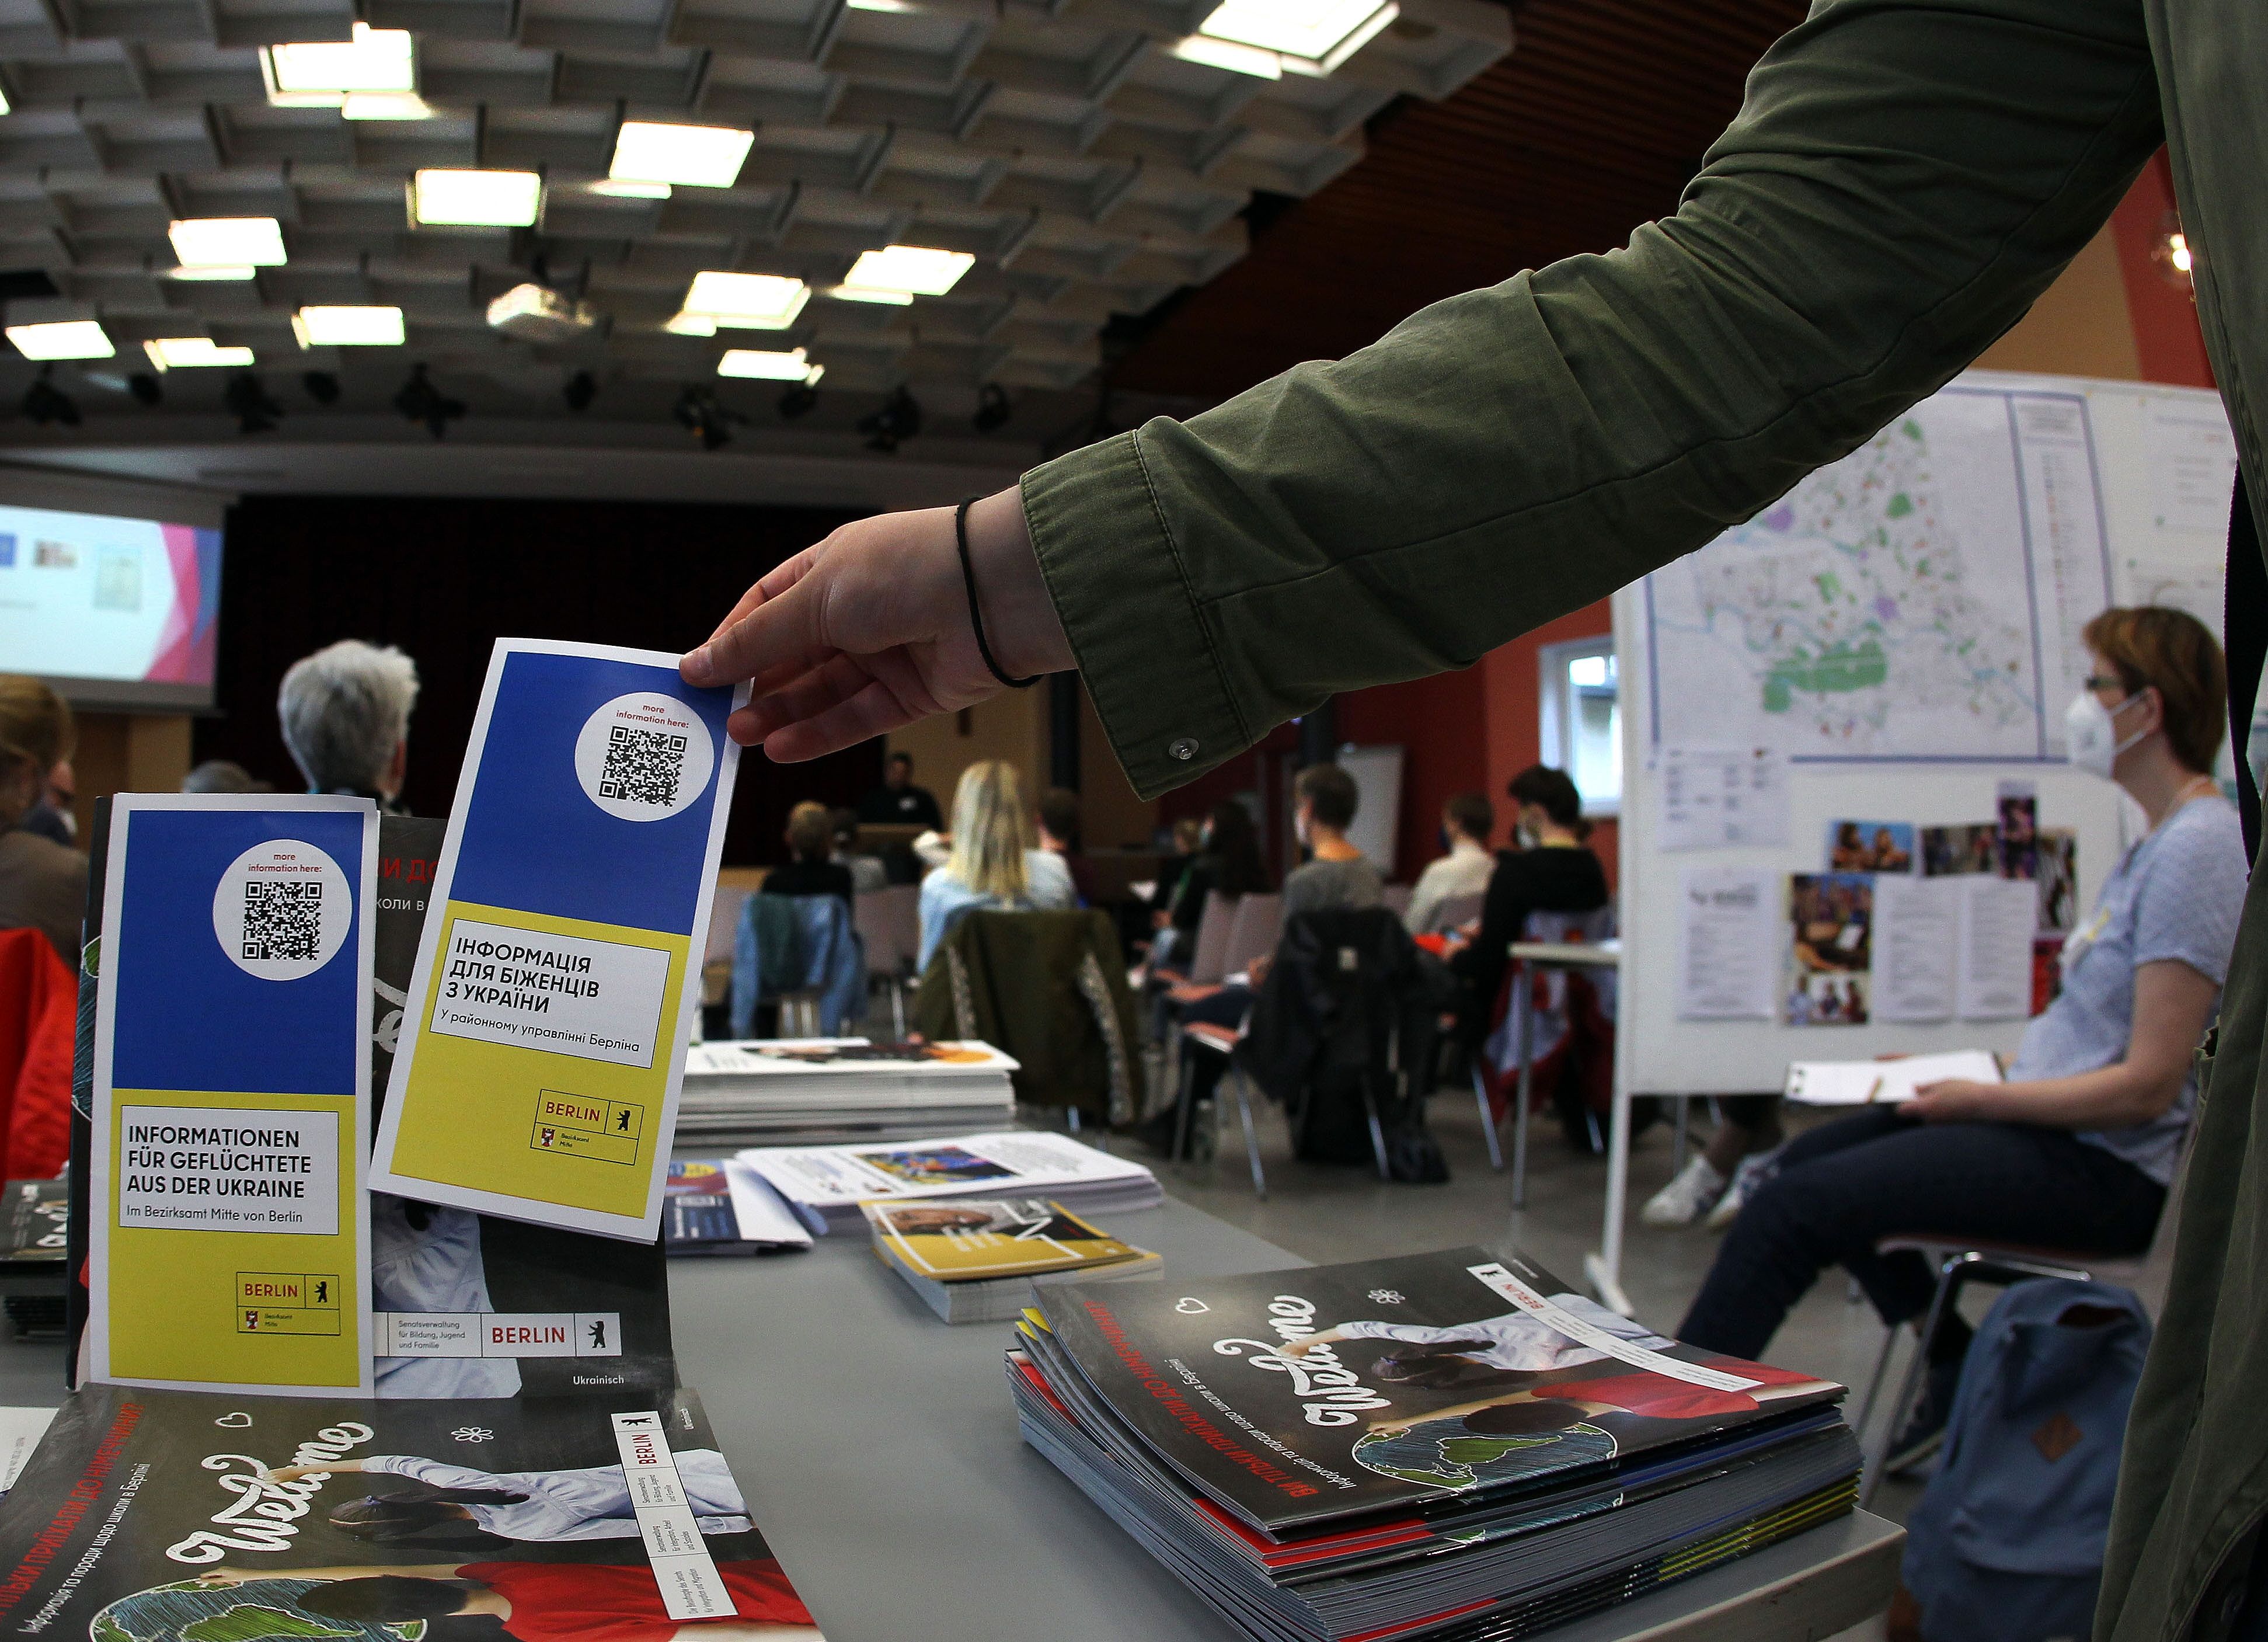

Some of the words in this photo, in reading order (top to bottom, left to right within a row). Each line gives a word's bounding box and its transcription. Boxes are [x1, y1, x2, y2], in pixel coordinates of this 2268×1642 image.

[616, 710, 665, 724] information
[667, 718, 689, 728] here:
[643, 705, 664, 714] more
[455, 937, 591, 973] ІНФОРМАЦІЯ
[450, 959, 494, 982] ДЛЯ
[500, 967, 600, 999] БІЖЕНЦІВ
[445, 982, 458, 999] З
[463, 983, 550, 1013] УКРАЇНИ
[451, 1013, 518, 1034] районному
[521, 1025, 586, 1043] управлінні
[590, 1034, 639, 1052] Берліна
[546, 1101, 600, 1122] BERLIN
[129, 1125, 299, 1147] INFORMATIONEN
[128, 1146, 165, 1168] FÜR
[171, 1149, 311, 1173] GEFLÜCHTETE
[127, 1175, 166, 1193] AUS
[172, 1177, 210, 1195] DER
[217, 1179, 304, 1198] UKRAINE
[127, 1205, 140, 1216] Im
[145, 1206, 207, 1219] Bezirksamt
[212, 1209, 240, 1220] Mitte
[243, 1213, 264, 1222] von
[269, 1210, 302, 1222] Berlin
[245, 1283, 298, 1297] BERLIN
[399, 1320, 459, 1329] Senatsverwaltung
[492, 1327, 565, 1343] BERLIN
[573, 1375, 624, 1385] Ukrainisch
[1144, 1380, 1183, 1397] ДО
[1200, 1390, 1231, 1412] школи
[1225, 1411, 1255, 1430] щодо
[632, 1434, 658, 1464] BERLIN
[1248, 1429, 1288, 1454] поради
[1224, 1449, 1293, 1483] ТІЛЬКИ
[1281, 1451, 1299, 1460] та
[1293, 1457, 1356, 1489] Інформація
[70, 1479, 103, 1501] ДО
[71, 1547, 103, 1577] поради
[92, 1523, 117, 1546] щодо
[106, 1498, 134, 1523] школи
